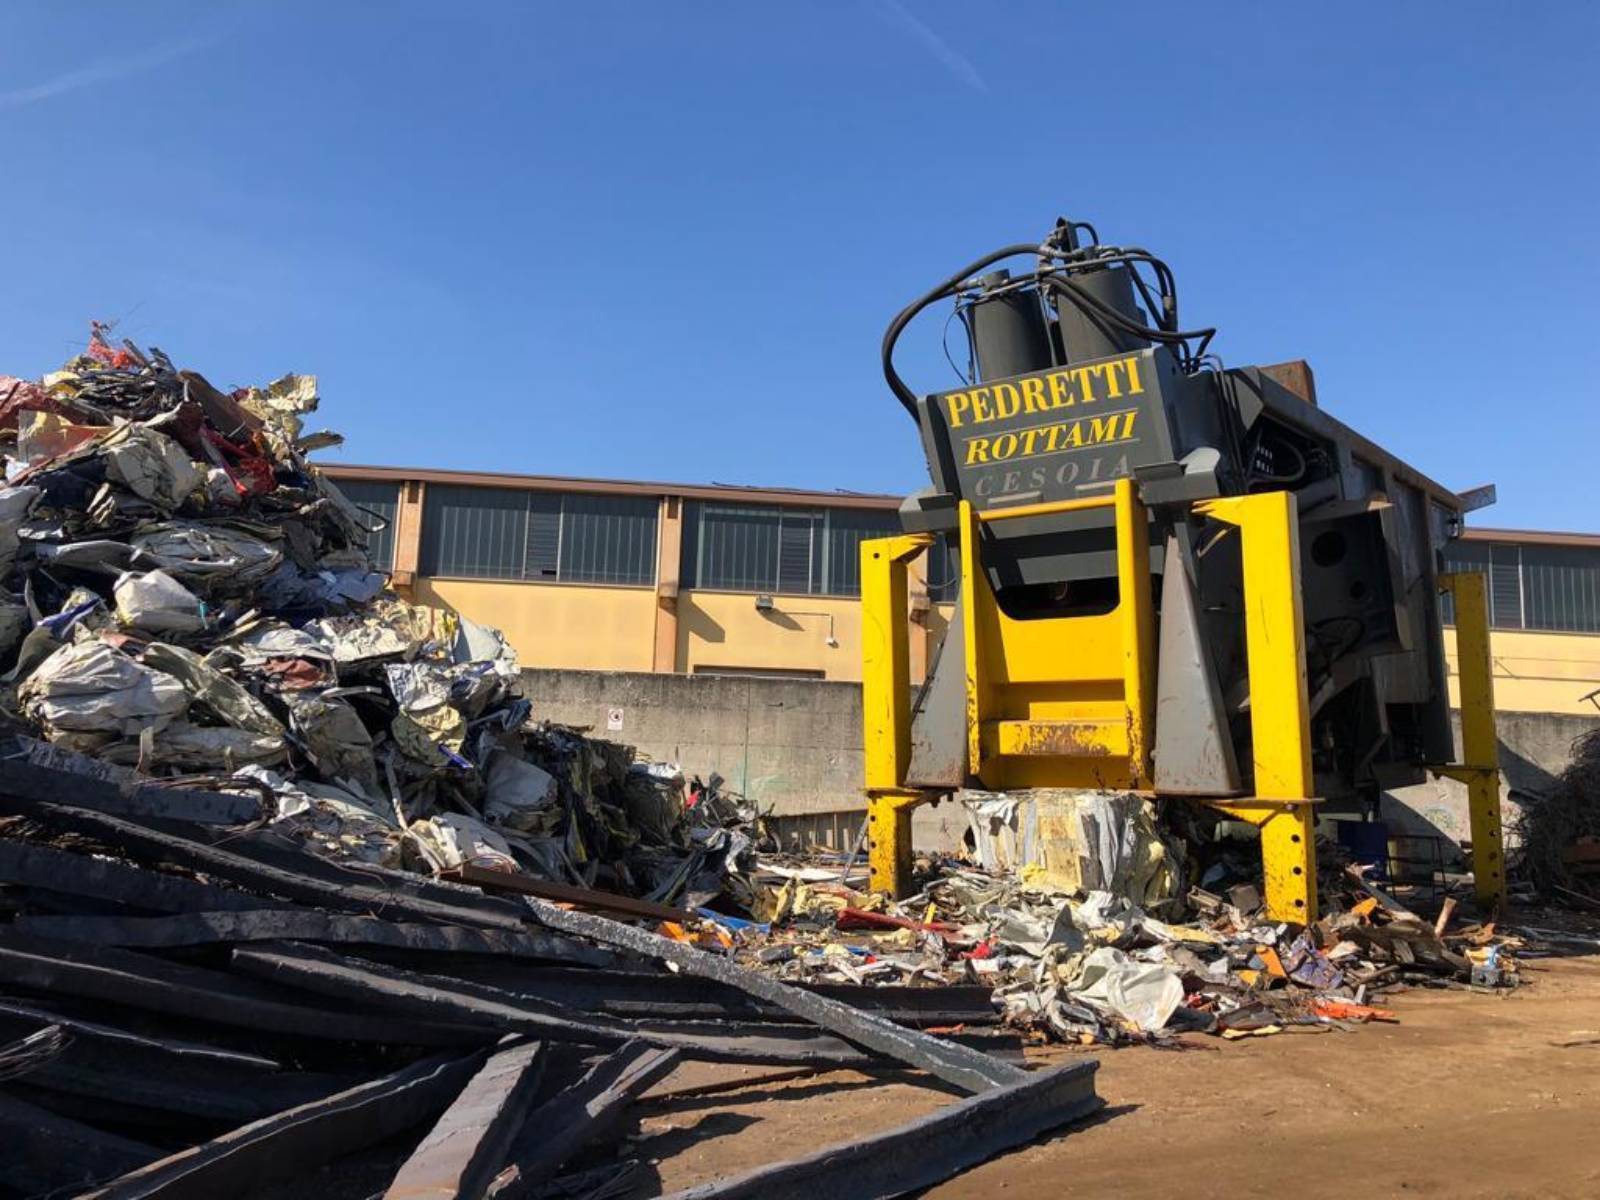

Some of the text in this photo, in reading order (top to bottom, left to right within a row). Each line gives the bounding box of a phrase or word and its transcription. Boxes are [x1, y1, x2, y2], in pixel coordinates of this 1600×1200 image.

[946, 358, 1143, 427] PEDRETTI
[966, 413, 1136, 464] ROTTAMI
[976, 455, 1129, 496] CESOIA
